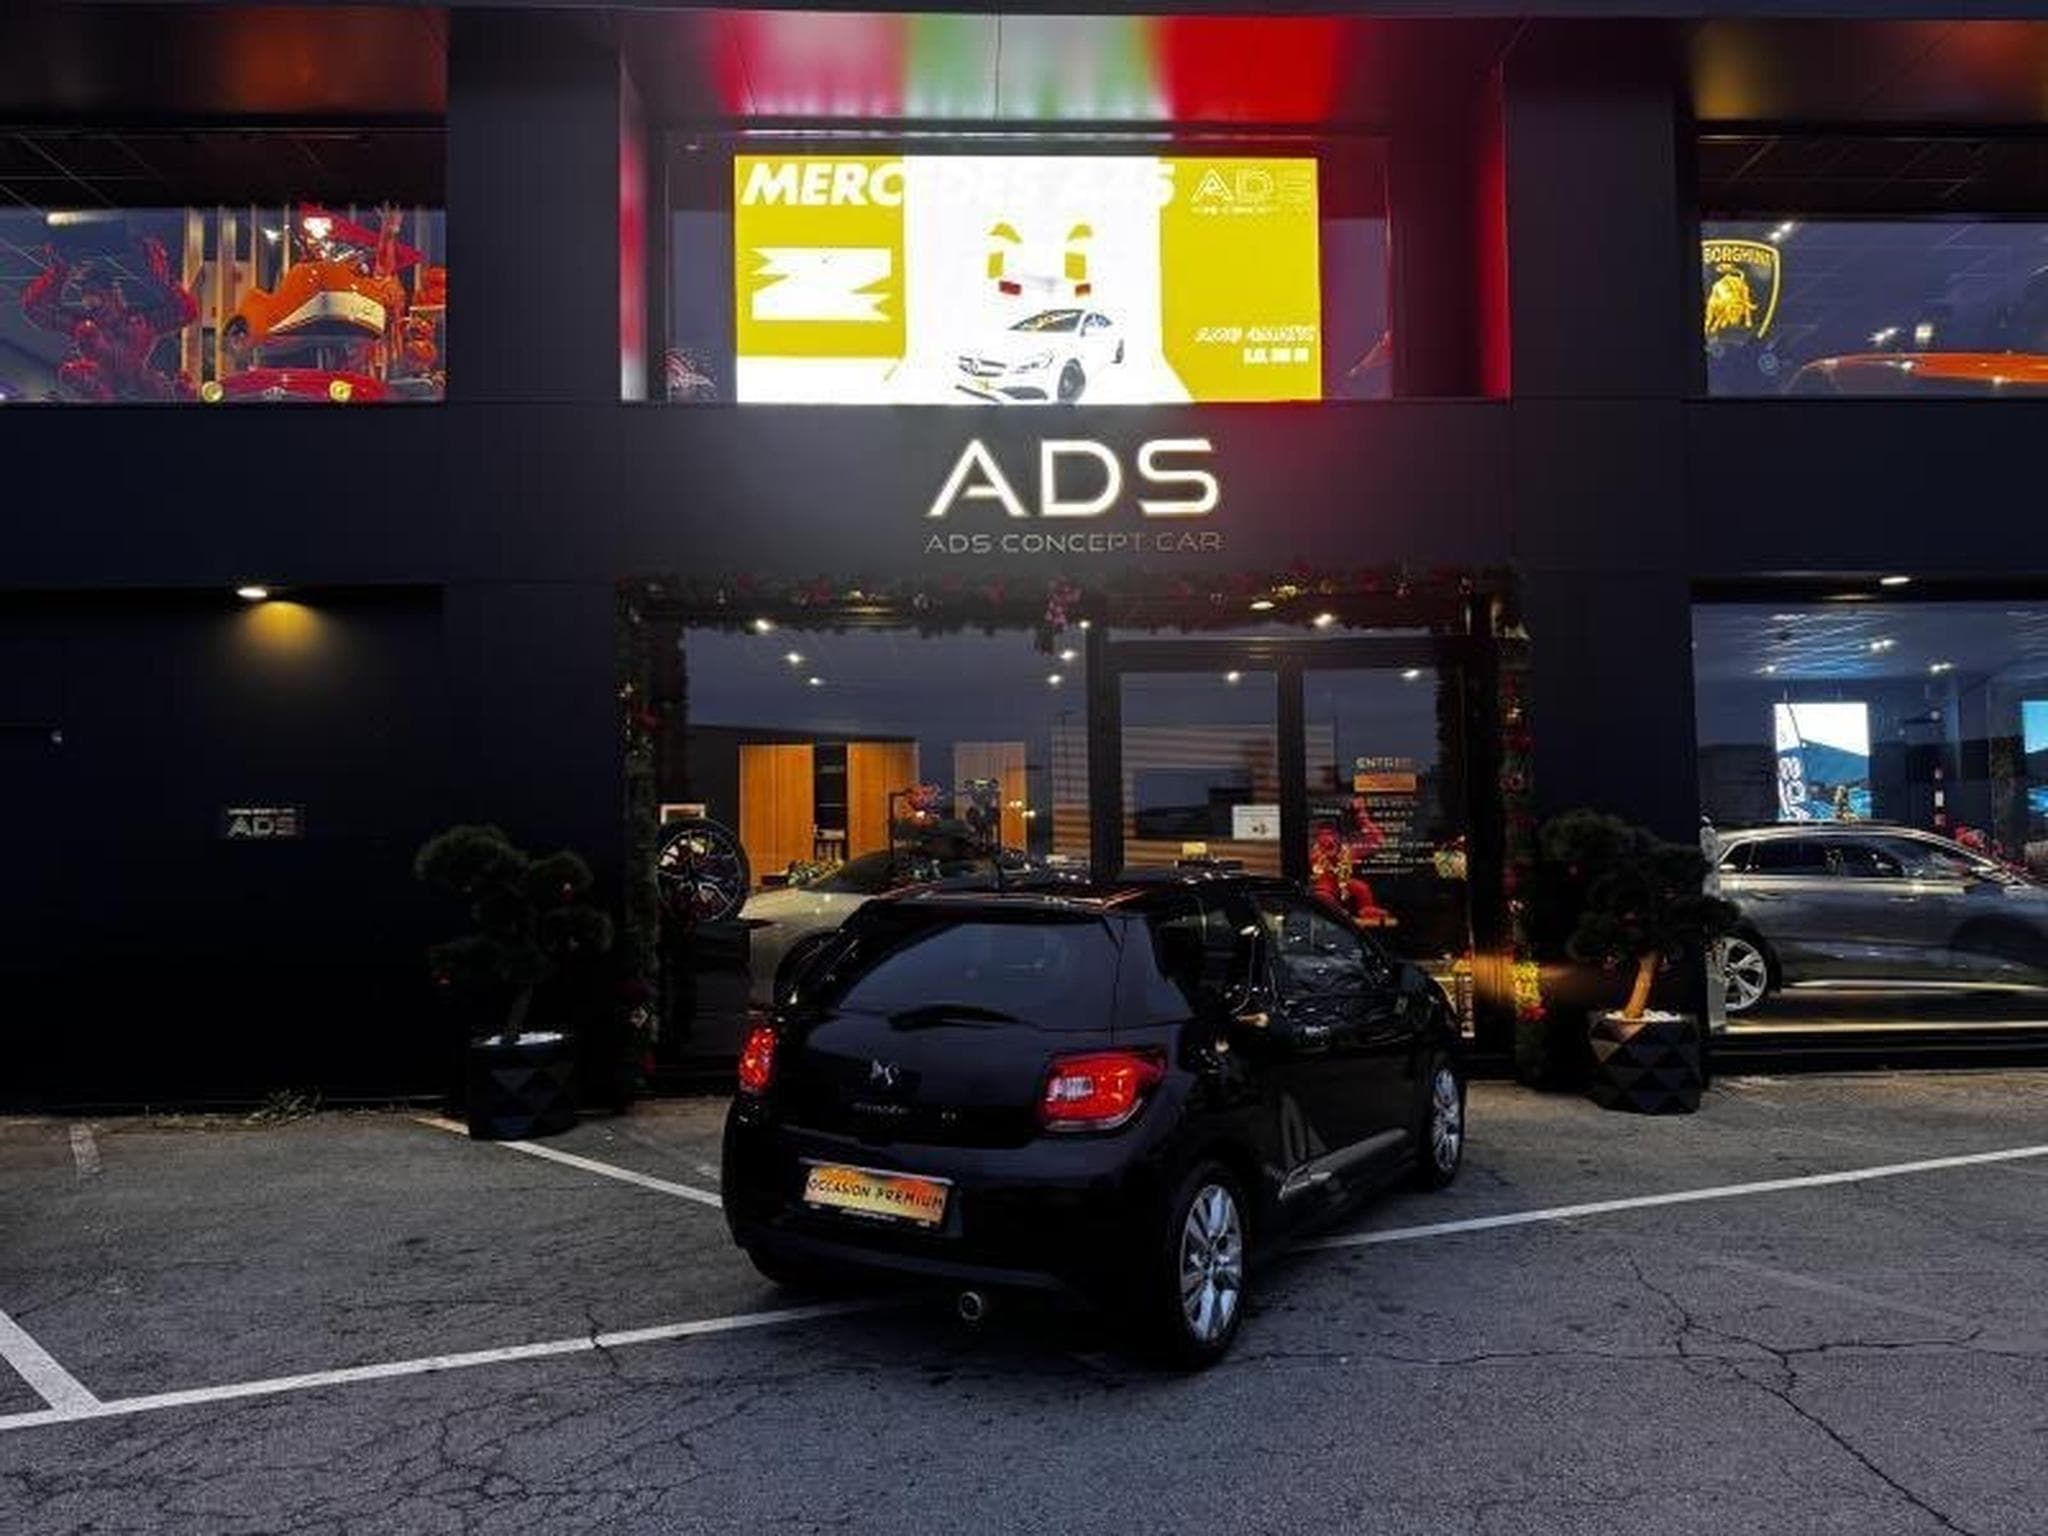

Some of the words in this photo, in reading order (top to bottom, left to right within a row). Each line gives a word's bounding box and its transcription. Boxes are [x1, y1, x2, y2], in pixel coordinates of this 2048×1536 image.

[926, 438, 1219, 517] ADS
[924, 533, 991, 554] ADS
[1001, 532, 1142, 554] CONCEPT
[1155, 531, 1222, 552] CAR
